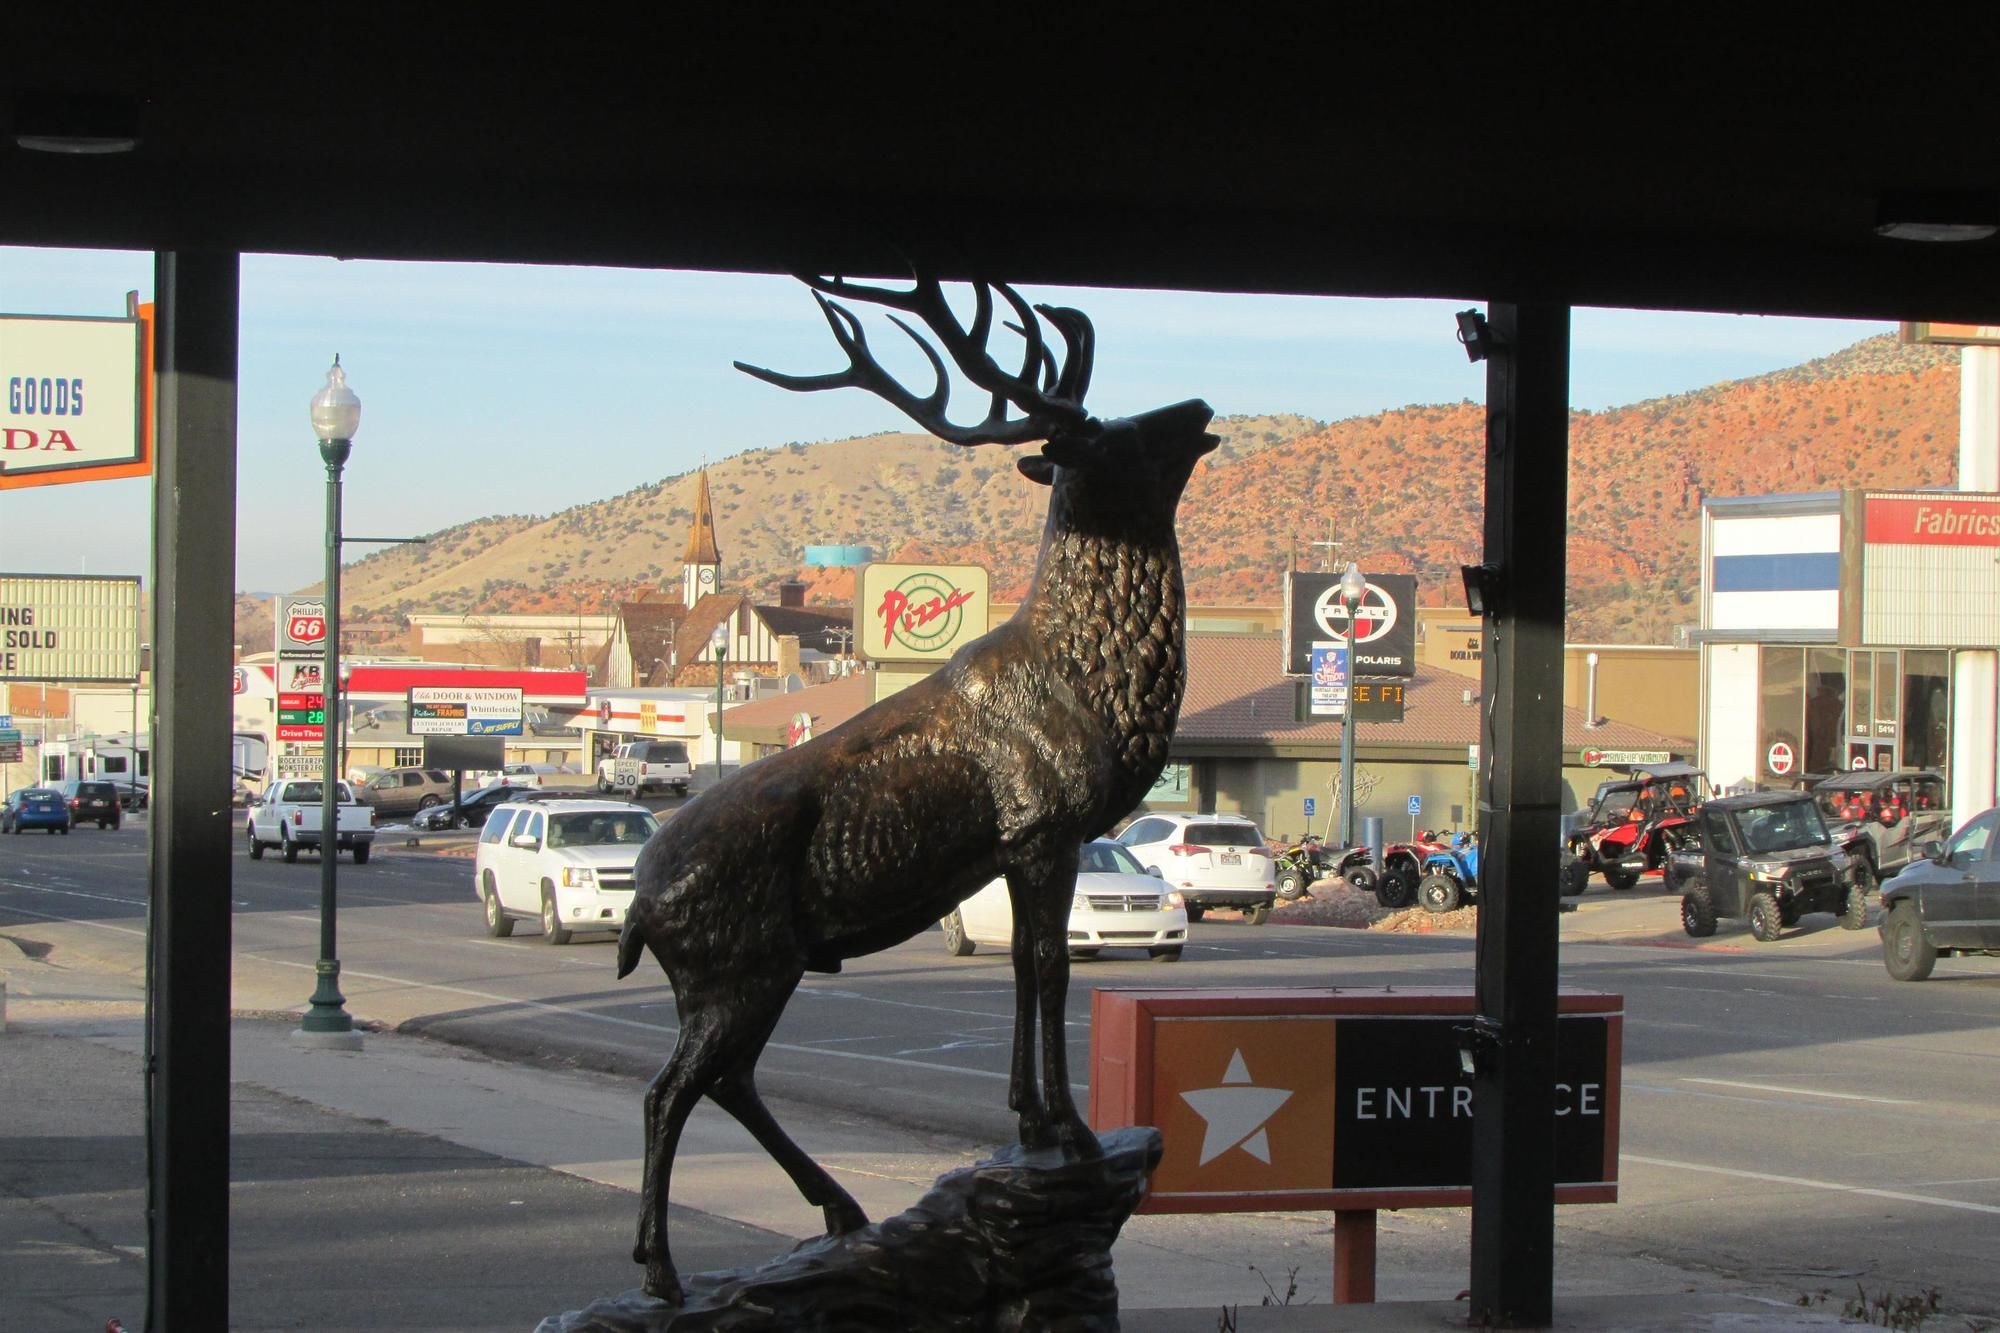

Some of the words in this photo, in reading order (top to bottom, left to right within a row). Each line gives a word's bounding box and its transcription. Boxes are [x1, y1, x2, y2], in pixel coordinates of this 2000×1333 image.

[9, 376, 83, 416] GOODS
[2, 427, 83, 452] DA
[1914, 506, 2000, 536] Fabrics
[292, 607, 324, 616] PHILLIPS
[1321, 607, 1389, 617] TRPLE
[877, 587, 976, 651] Pizza
[293, 619, 321, 637] 66
[6, 630, 57, 649] SOLD
[1355, 655, 1402, 666] POLARIS
[295, 665, 320, 678] KB
[308, 695, 323, 709] 2.4
[433, 691, 463, 700] DOOR
[465, 691, 472, 700] &
[474, 692, 518, 701] WINDOW
[437, 708, 465, 717] FRAMING
[471, 705, 521, 713] Whittlesticks
[308, 711, 324, 724] 2.8
[616, 774, 636, 786] 30
[1357, 1083, 1601, 1120] ENTRCE
